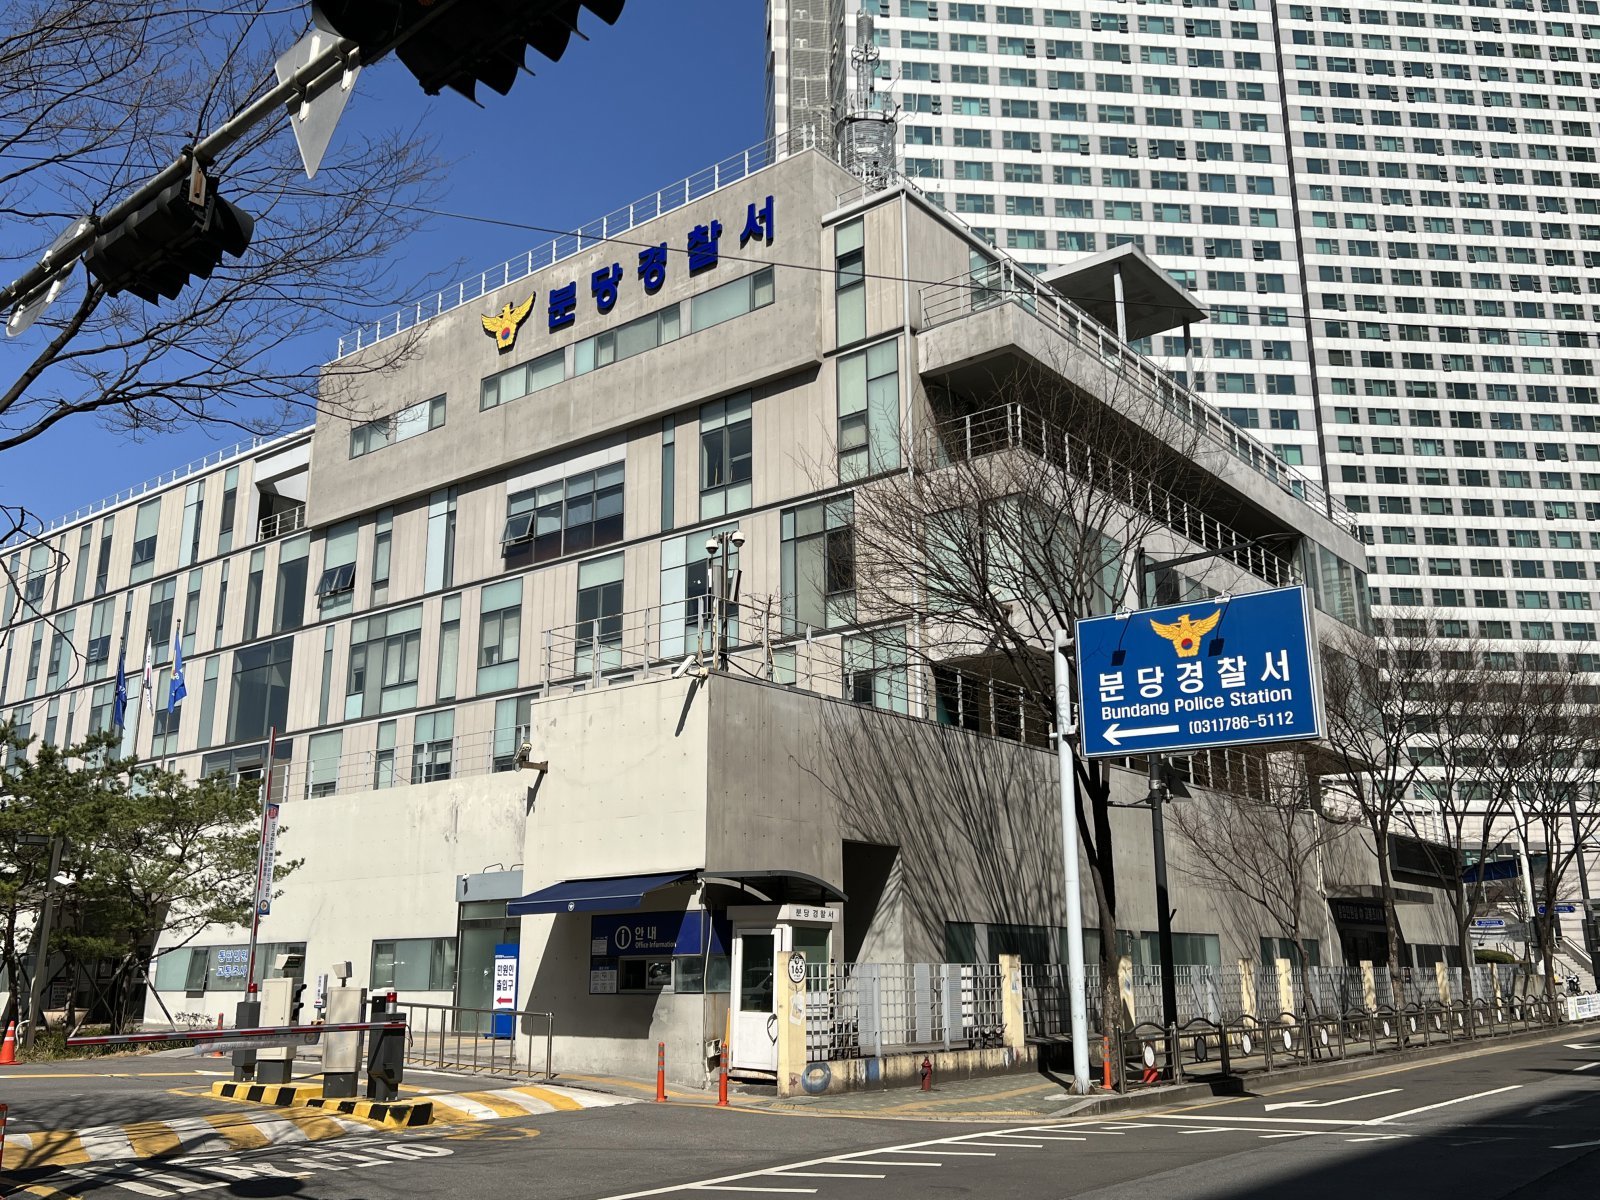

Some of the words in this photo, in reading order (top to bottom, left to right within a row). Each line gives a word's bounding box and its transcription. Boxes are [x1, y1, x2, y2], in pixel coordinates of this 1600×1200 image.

[548, 195, 774, 328] 분당경찰서
[1098, 650, 1291, 703] 분당경찰서
[1101, 702, 1170, 721] Bundang
[1174, 695, 1225, 713] Police
[1230, 686, 1293, 708] Station
[1188, 710, 1295, 735] (031)786-5112
[634, 941, 649, 949] Office
[650, 940, 677, 949] Information
[497, 964, 514, 976] 민원인
[791, 965, 804, 974] 165
[496, 979, 514, 991] 출입구
